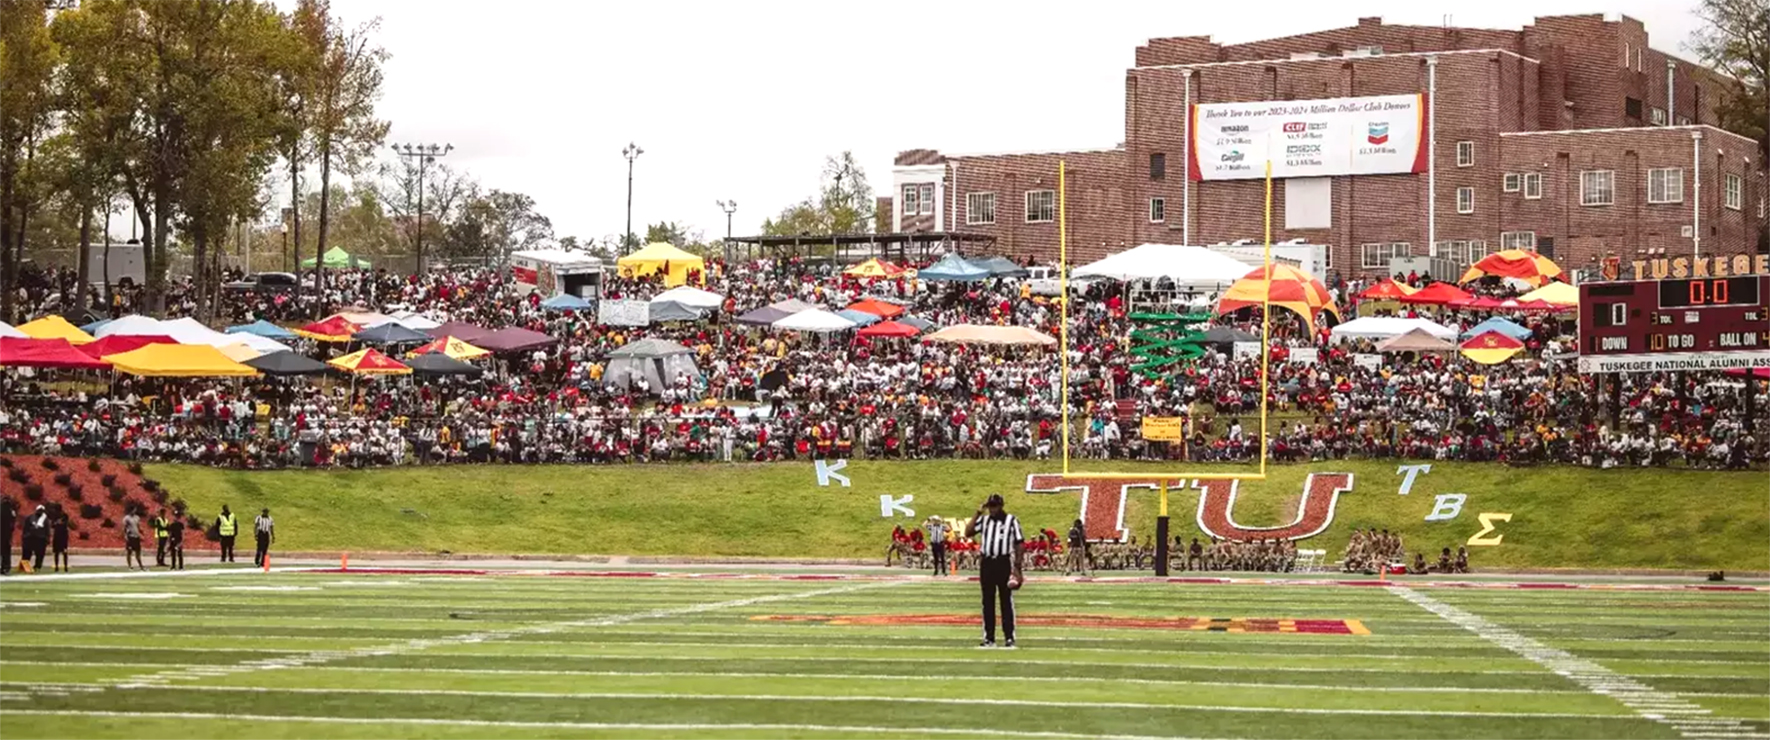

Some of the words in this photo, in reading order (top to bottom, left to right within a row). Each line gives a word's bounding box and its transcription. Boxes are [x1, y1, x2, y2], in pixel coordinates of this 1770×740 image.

[1244, 109, 1252, 117] to
[1253, 109, 1267, 117] our
[1310, 103, 1336, 114] Million
[1338, 102, 1362, 112] Dollar
[1363, 101, 1382, 112] Club
[1383, 101, 1411, 111] Donors
[1745, 312, 1758, 320] TOL
[1602, 337, 1628, 350] DOWN
[1651, 334, 1664, 350] 10
[1668, 335, 1679, 348] TO
[1681, 334, 1694, 348] GO
[1720, 333, 1742, 346] BALL
[1743, 332, 1757, 345] ON
[1600, 361, 1652, 371] TUSKEGEE
[1655, 360, 1706, 369] NATIONAL
[1709, 359, 1749, 368] ALUMNI
[815, 459, 851, 487] K
[1397, 464, 1431, 495] T
[880, 494, 915, 517] K
[1026, 473, 1354, 544] TU
[1424, 493, 1467, 521] B
